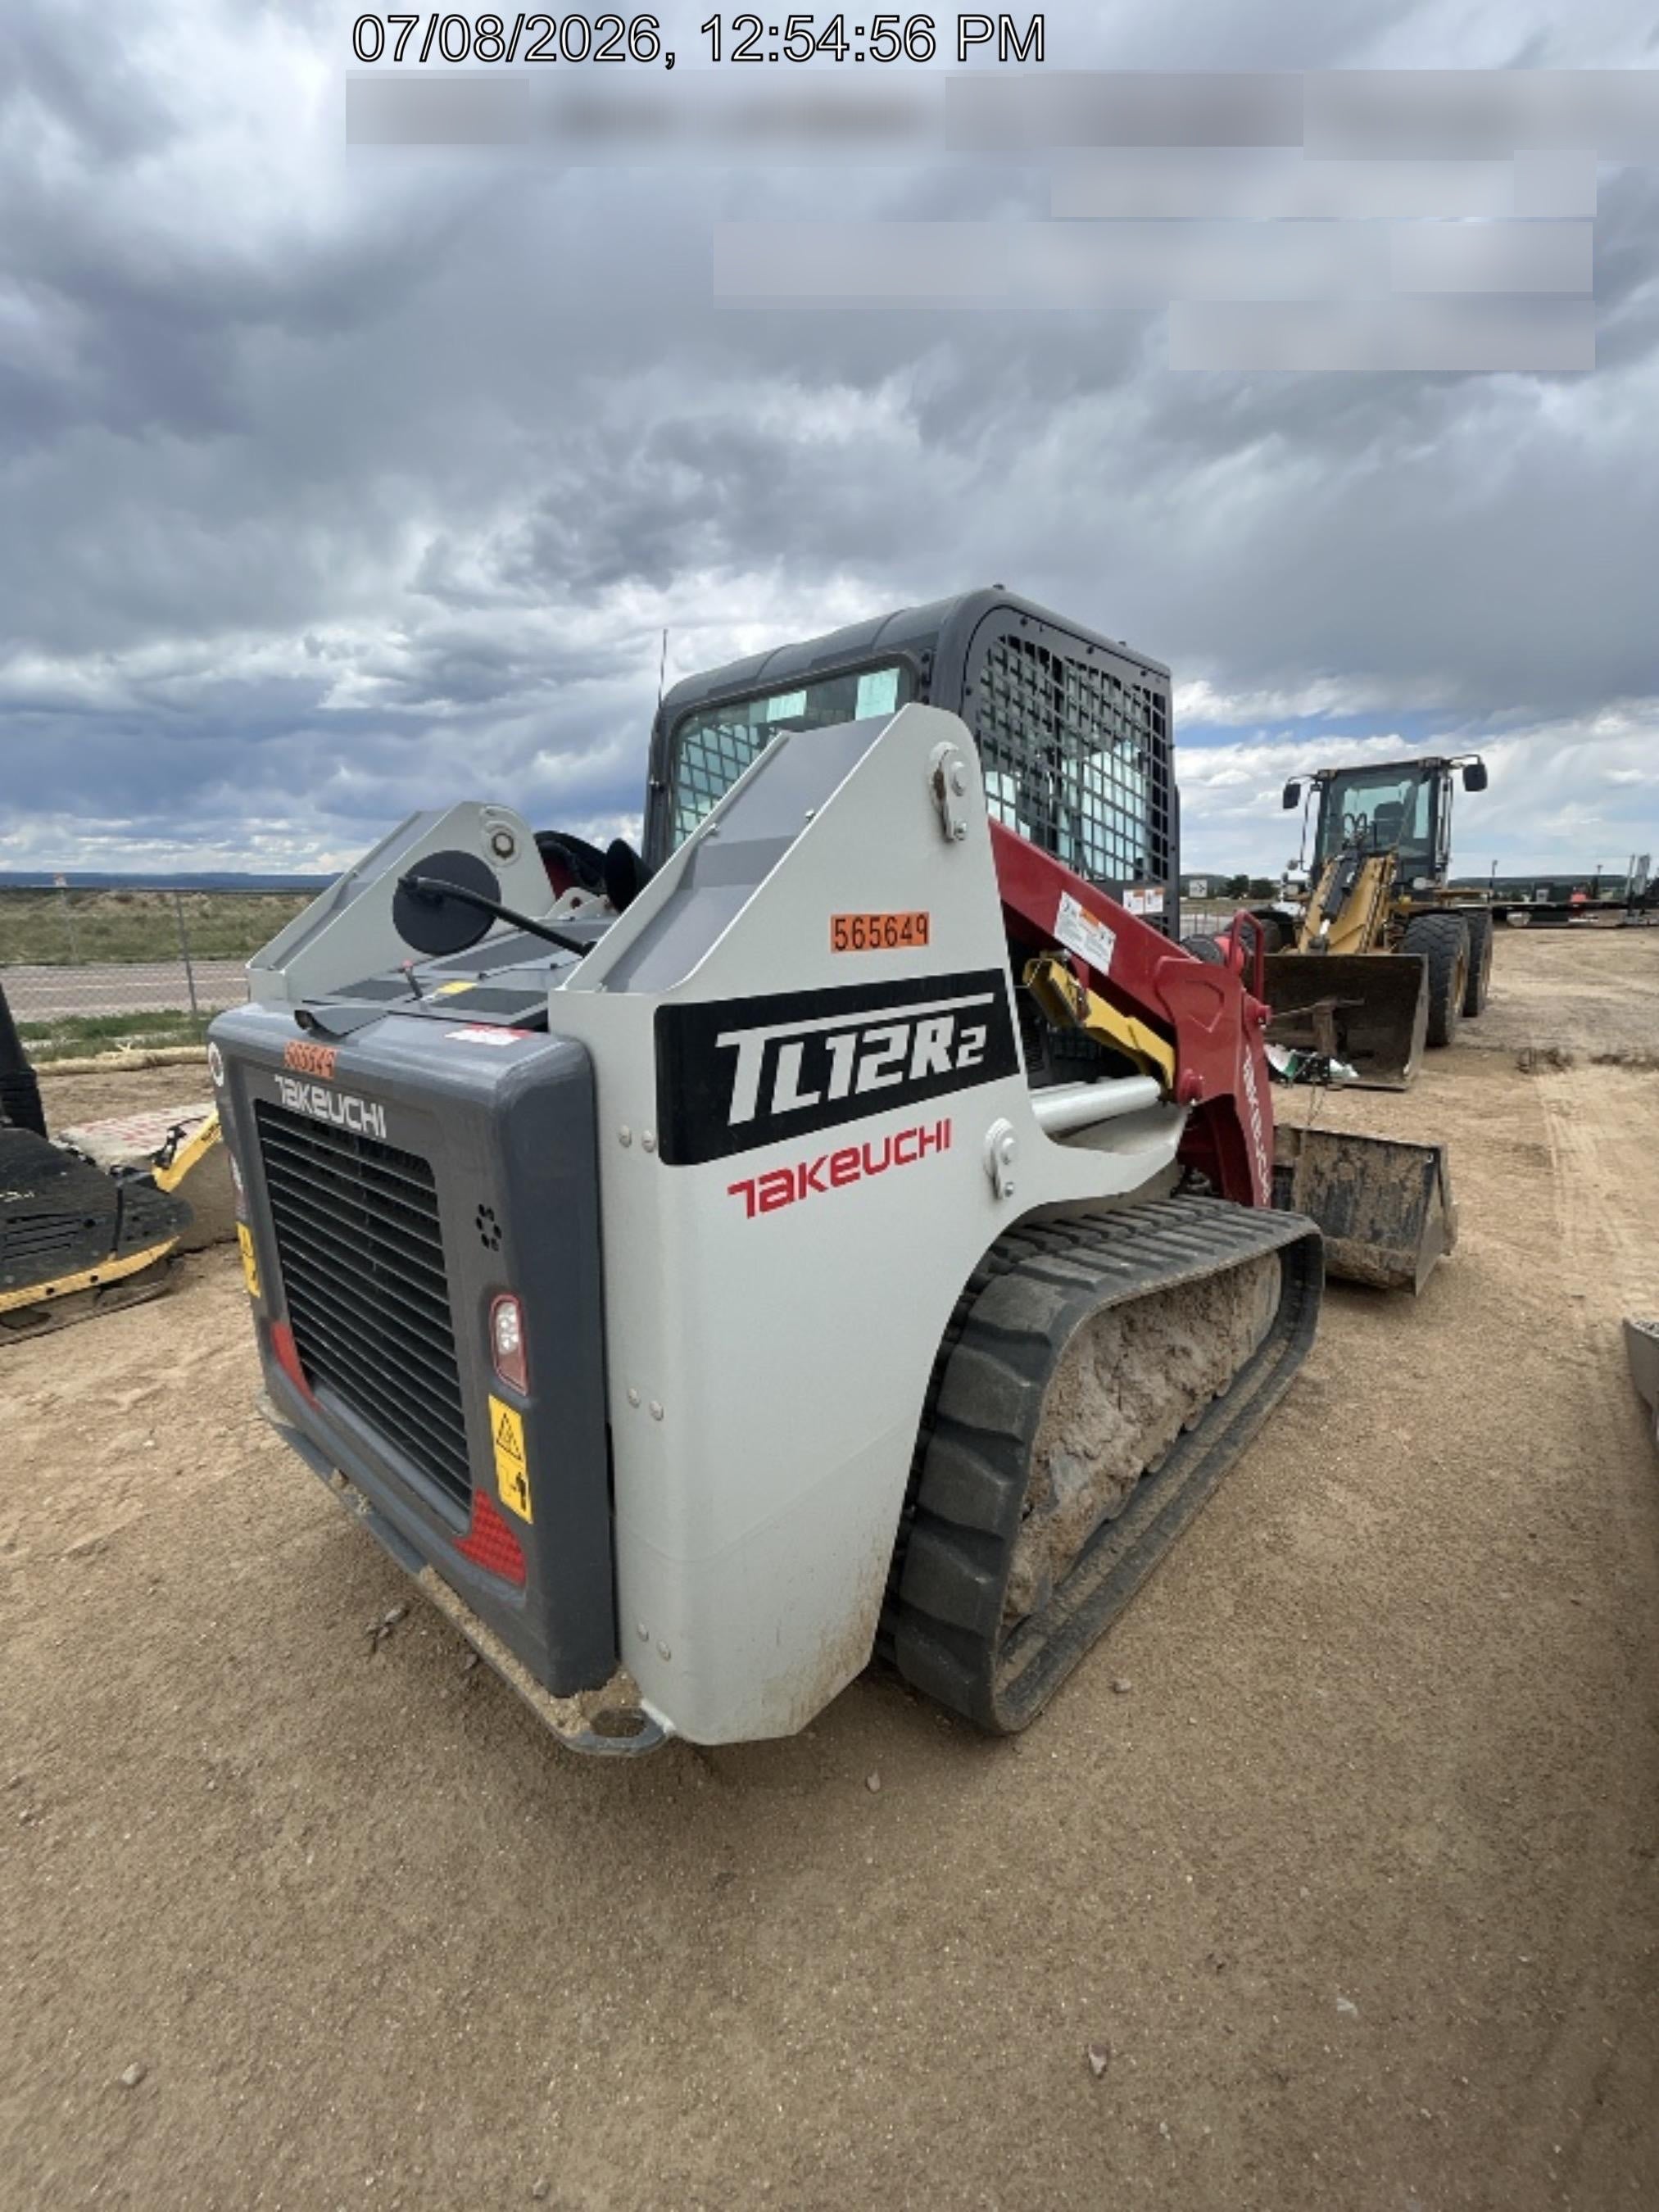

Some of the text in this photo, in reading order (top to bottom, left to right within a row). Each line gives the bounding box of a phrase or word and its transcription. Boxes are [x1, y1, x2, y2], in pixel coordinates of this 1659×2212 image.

[834, 913, 930, 950] 565649
[714, 991, 995, 1127] TL12R2
[274, 1074, 387, 1139] TAKEUCHI
[727, 1117, 952, 1219] TAKEUCHI
